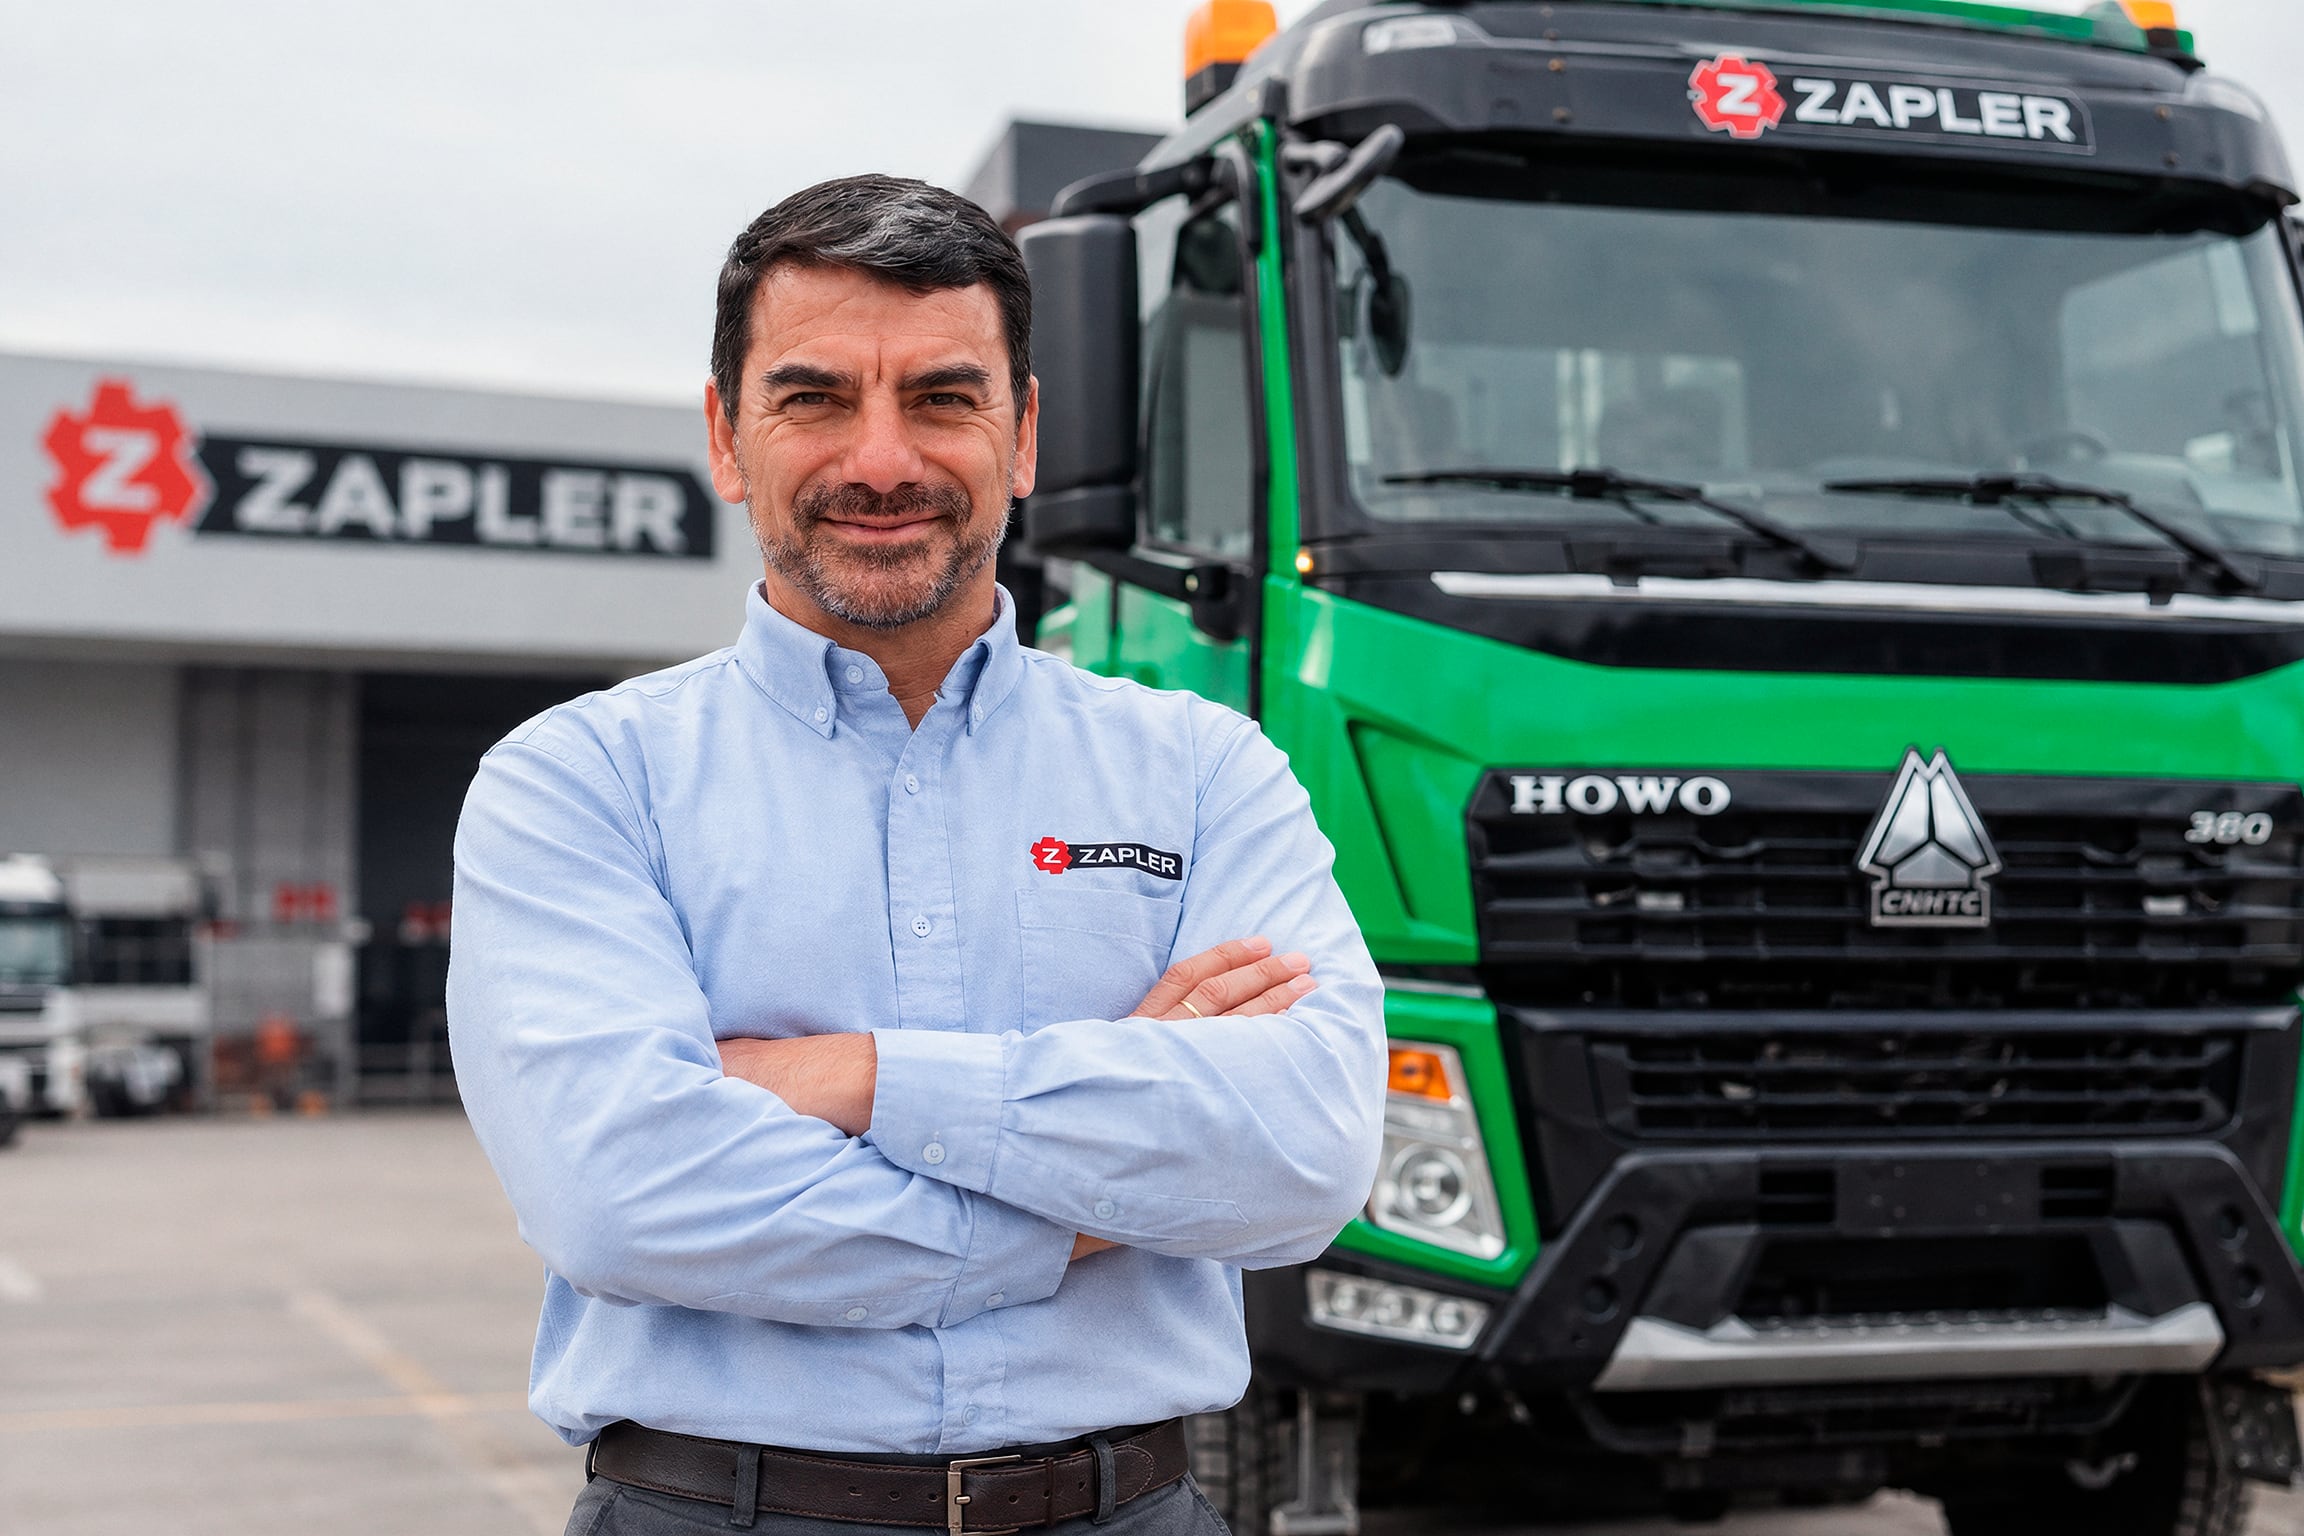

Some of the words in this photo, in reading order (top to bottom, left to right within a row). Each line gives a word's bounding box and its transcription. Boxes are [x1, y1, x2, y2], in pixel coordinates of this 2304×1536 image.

[1716, 74, 1760, 115] Z
[1793, 78, 2076, 142] ZAPLER
[80, 427, 161, 511] Z
[234, 446, 691, 553] ZAPLER
[1510, 775, 1731, 815] HOWO
[1042, 848, 1062, 863] Z
[1079, 848, 1175, 874] ZAPLER
